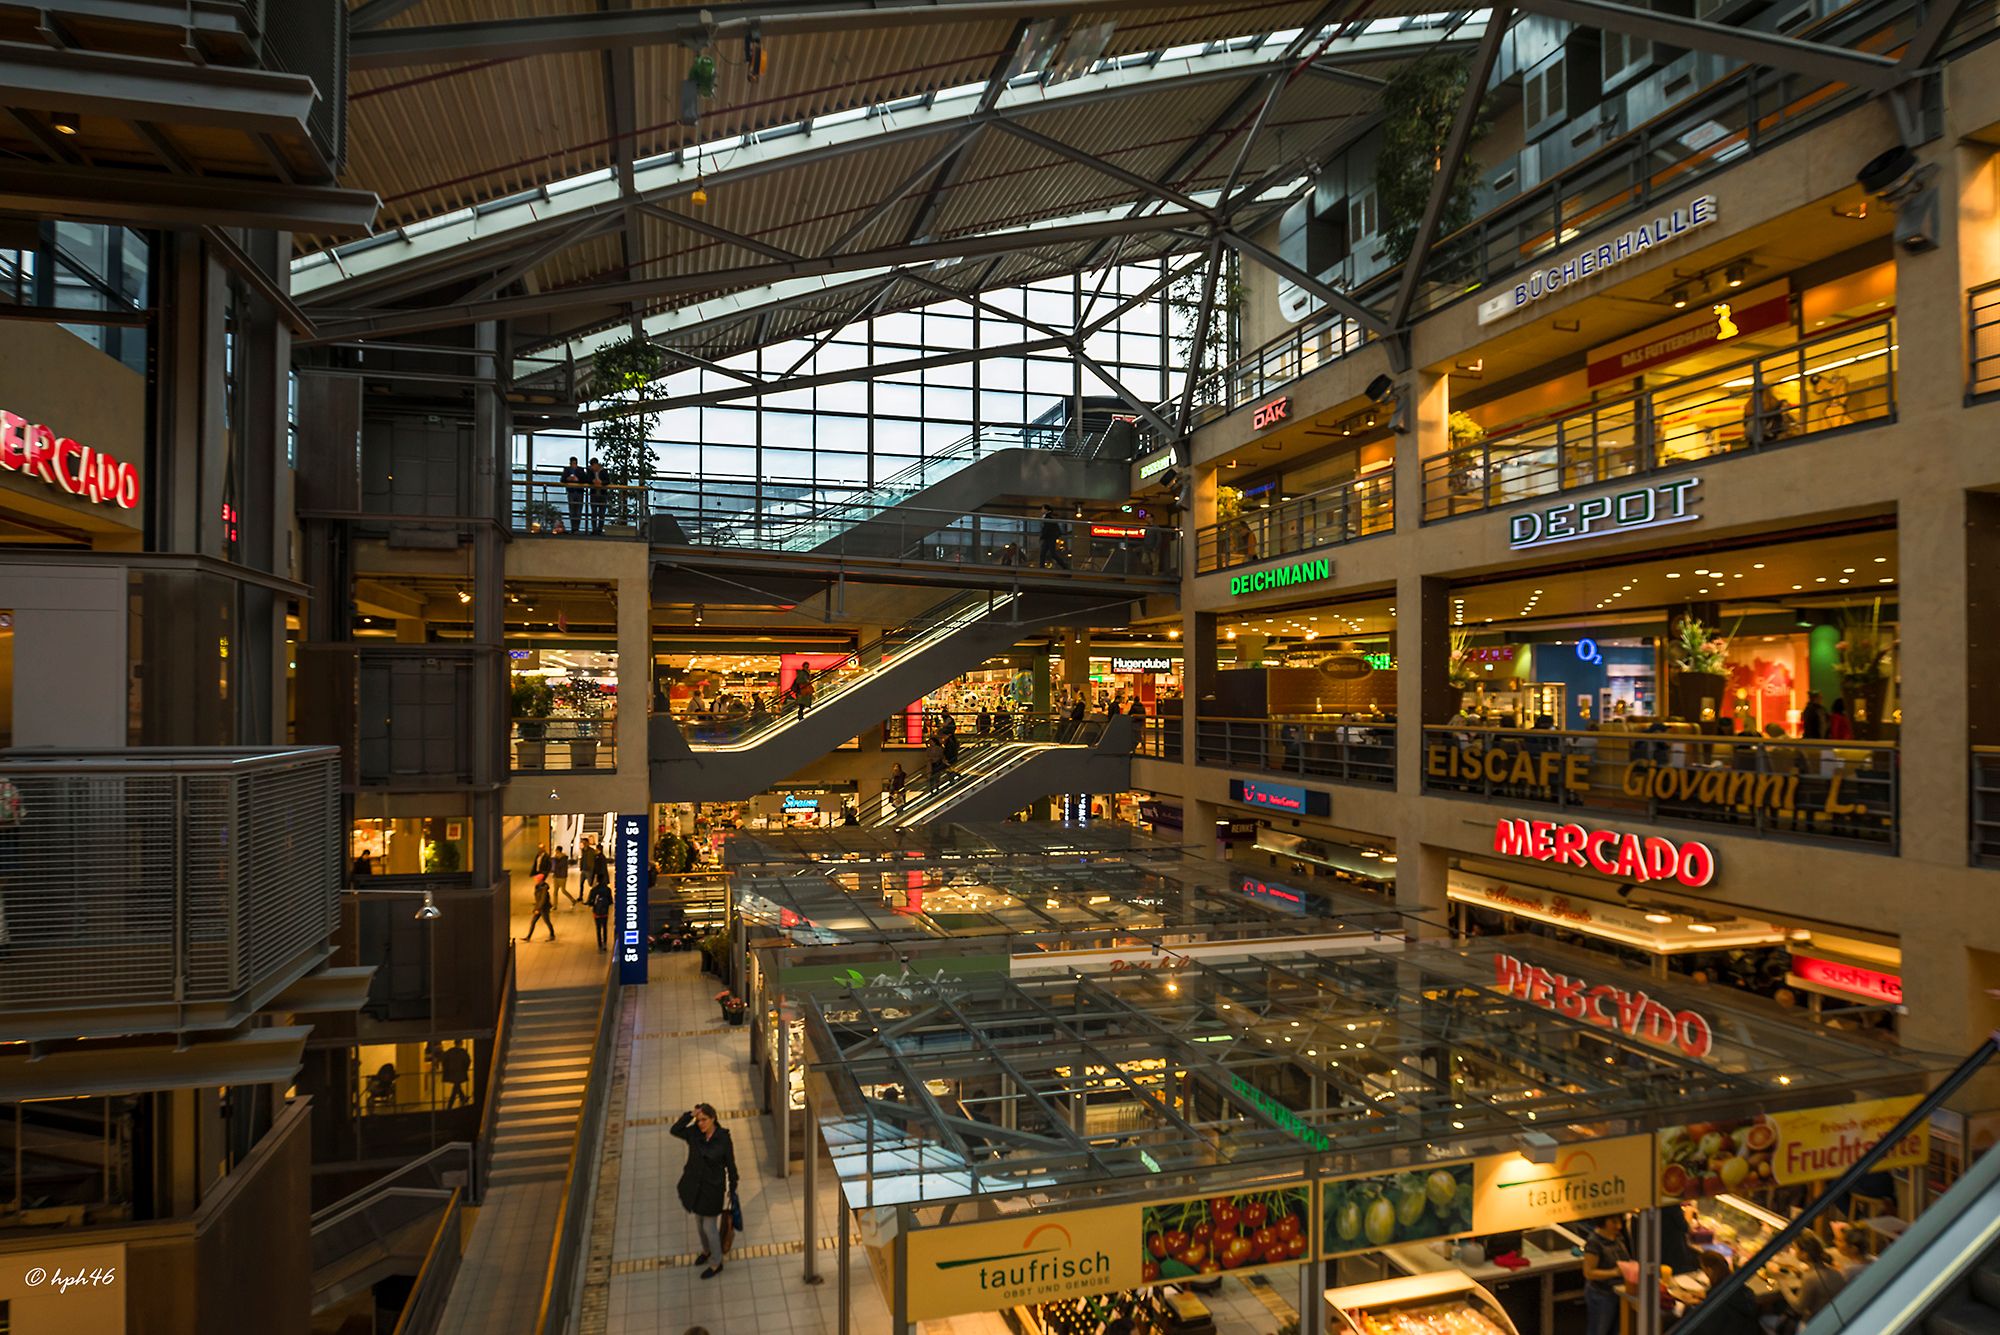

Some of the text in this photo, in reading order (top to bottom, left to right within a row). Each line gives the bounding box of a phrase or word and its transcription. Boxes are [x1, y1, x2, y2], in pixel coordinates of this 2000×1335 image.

[1515, 195, 1717, 306] BÜCHERHALLE
[1253, 397, 1287, 430] DAK
[1510, 477, 1700, 545] DEPOT
[1230, 558, 1329, 595] DEICHMANN
[1113, 657, 1170, 669] Hugendubel
[1428, 744, 1868, 815] EISCAFE Giovanni L.
[1494, 818, 1714, 887] MERCADO
[626, 840, 638, 930] BUDNIKOWSKY
[1528, 1174, 1625, 1208] taufrisch
[979, 1251, 1110, 1290] taufrisch
[1003, 1276, 1111, 1299] OBST UND GEMÜSE
